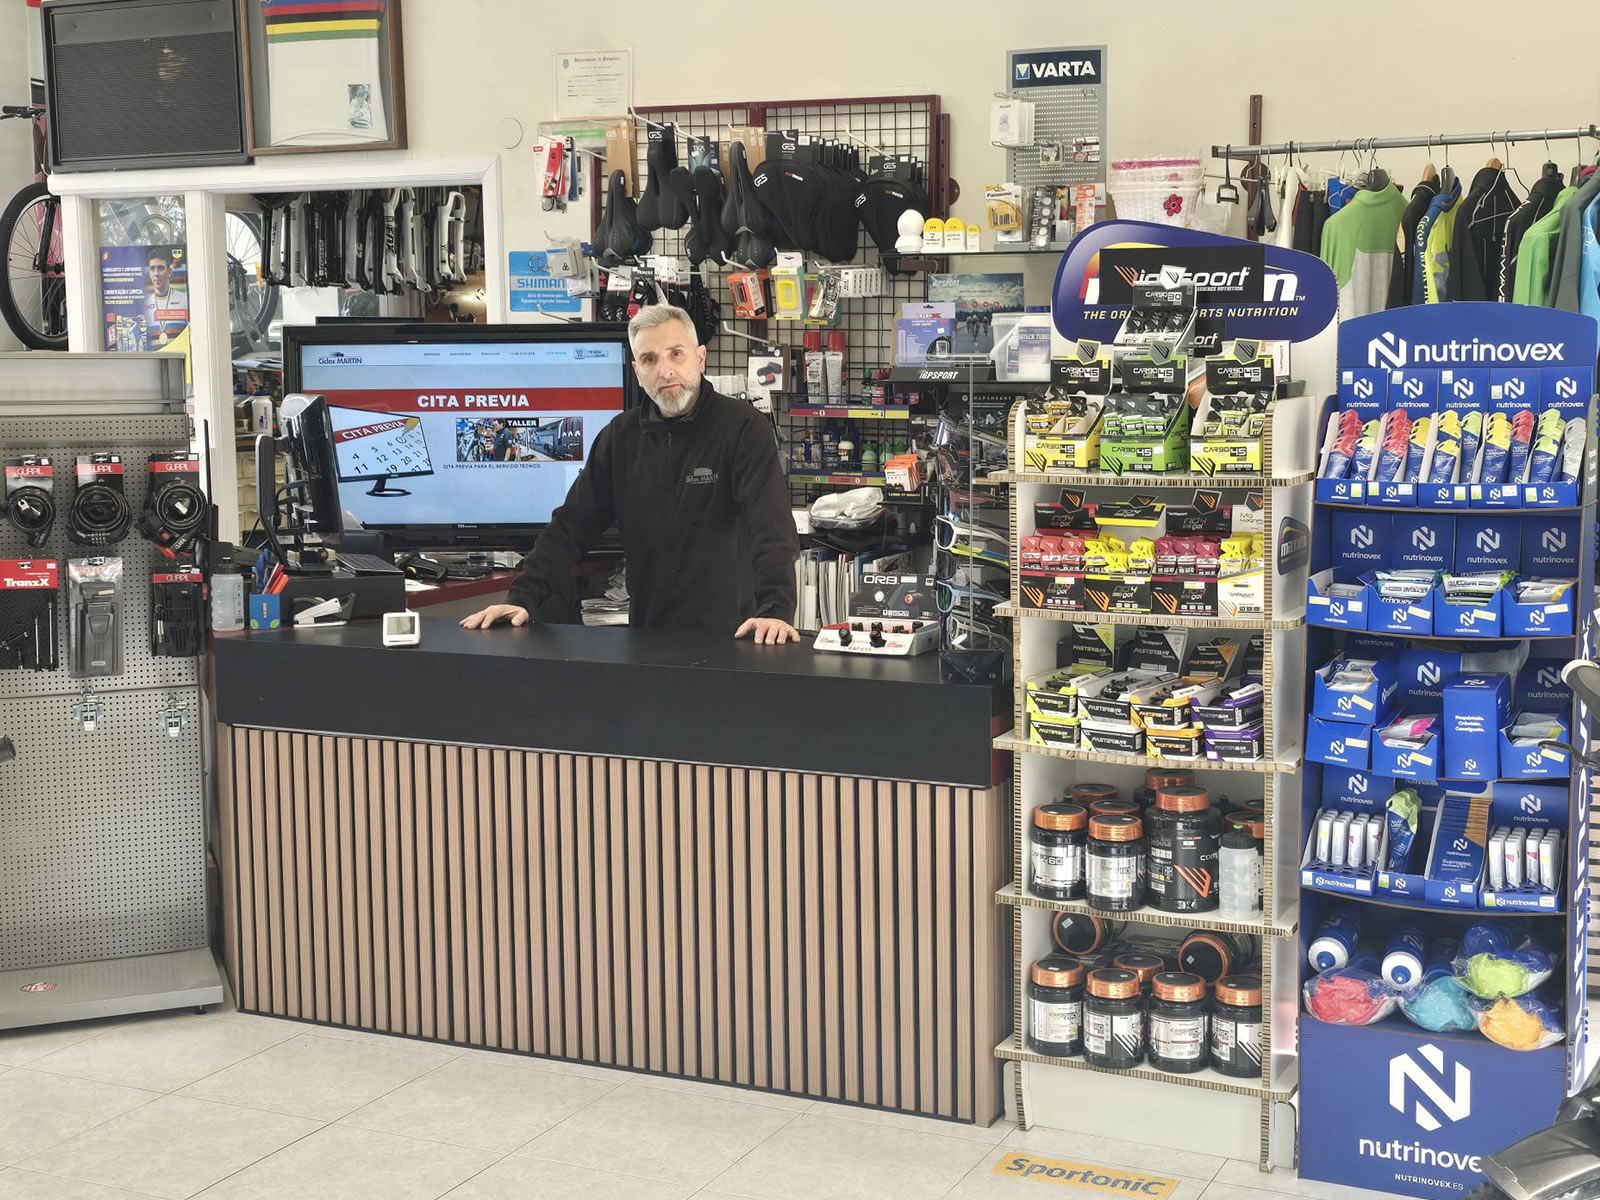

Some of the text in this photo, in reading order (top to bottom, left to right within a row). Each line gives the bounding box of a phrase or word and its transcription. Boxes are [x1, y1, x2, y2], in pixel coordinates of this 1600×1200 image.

[1032, 60, 1096, 79] VARTA
[517, 278, 566, 289] SHIMAN
[1083, 311, 1106, 321] THE
[1228, 307, 1299, 319] NUTRITION
[1413, 337, 1565, 362] nutrinovex
[337, 356, 363, 365] MARTIN
[919, 370, 960, 380] iGPSPORT
[1060, 367, 1100, 379] CARBO 45
[1133, 367, 1174, 379] CARBO 45
[1217, 367, 1261, 378] CARBO 45
[417, 393, 530, 409] CITA PREVIA
[1548, 400, 1585, 409] nutrinovex
[341, 420, 406, 442] CITA PREVIA
[1060, 443, 1075, 454] 45
[1136, 447, 1153, 458] 45
[1230, 446, 1248, 458] 45
[353, 463, 369, 475] 11
[376, 454, 389, 464] 12
[392, 447, 403, 456] 13
[385, 465, 399, 476] 19
[401, 456, 412, 465] 20
[1342, 551, 1381, 561] nutrinovex
[1403, 553, 1443, 563] nutrinovex
[1466, 556, 1508, 566] nutrinovex
[1533, 556, 1575, 566] nutrinovex
[863, 575, 898, 585] ORB
[1408, 688, 1444, 698] nutrinove
[1527, 690, 1570, 700] nutrinovex
[1571, 614, 1593, 1082] nutrinovx
[1358, 1138, 1484, 1175] nutrinove
[1395, 1173, 1465, 1192] NUTRINOVEX.ES
